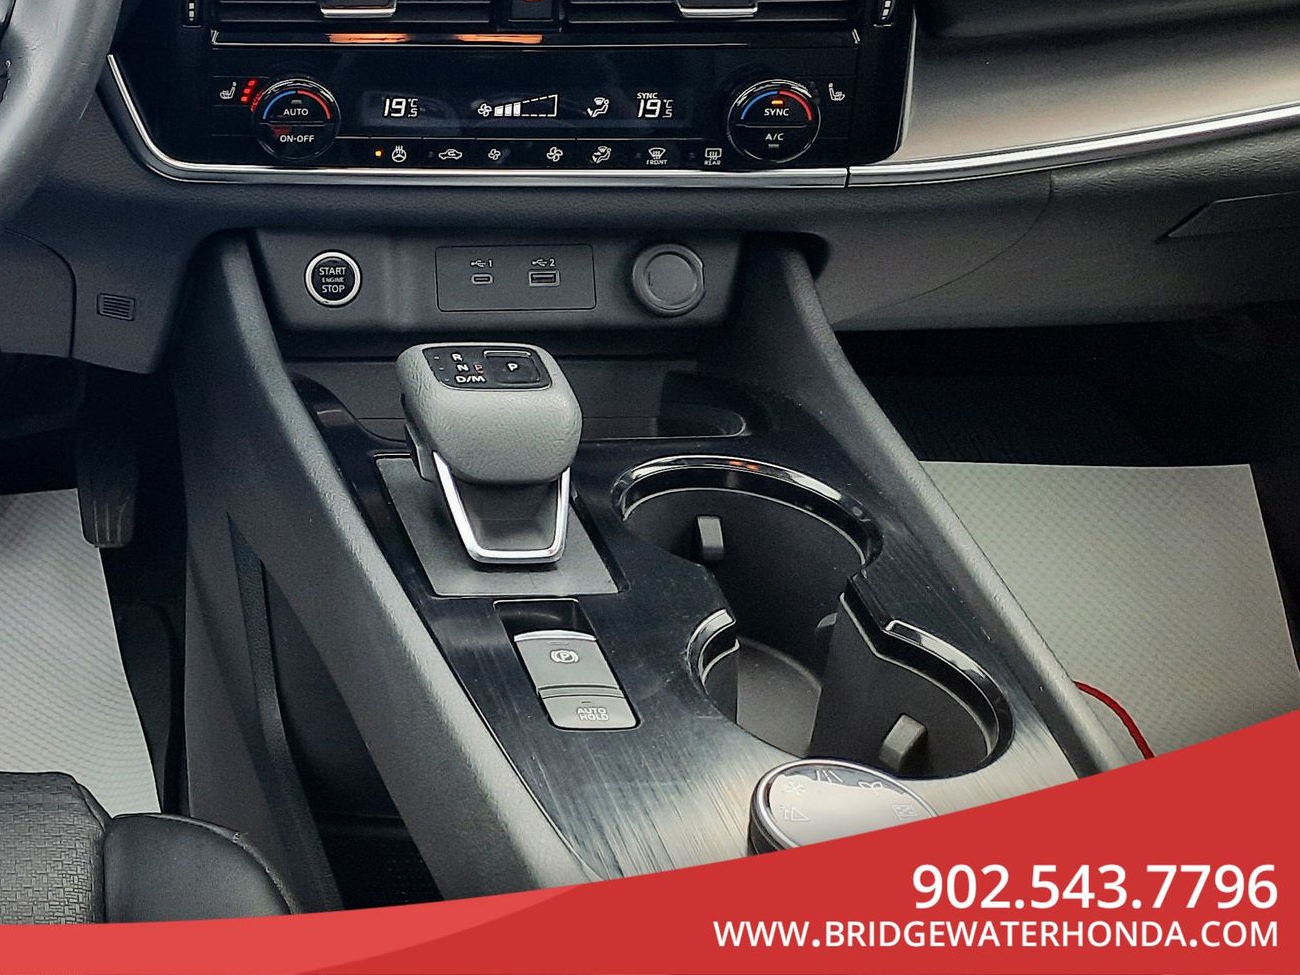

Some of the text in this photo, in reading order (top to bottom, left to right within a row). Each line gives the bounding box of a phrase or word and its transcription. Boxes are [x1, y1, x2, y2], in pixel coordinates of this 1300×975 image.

[283, 108, 309, 117] AUTO
[764, 107, 790, 117] SYNC
[765, 132, 784, 142] A/C
[549, 258, 555, 267] 2
[319, 267, 347, 276] START
[321, 285, 346, 293] STOP
[451, 353, 463, 362] R
[457, 364, 469, 372] N
[507, 362, 518, 371] P
[455, 375, 486, 383] D/M
